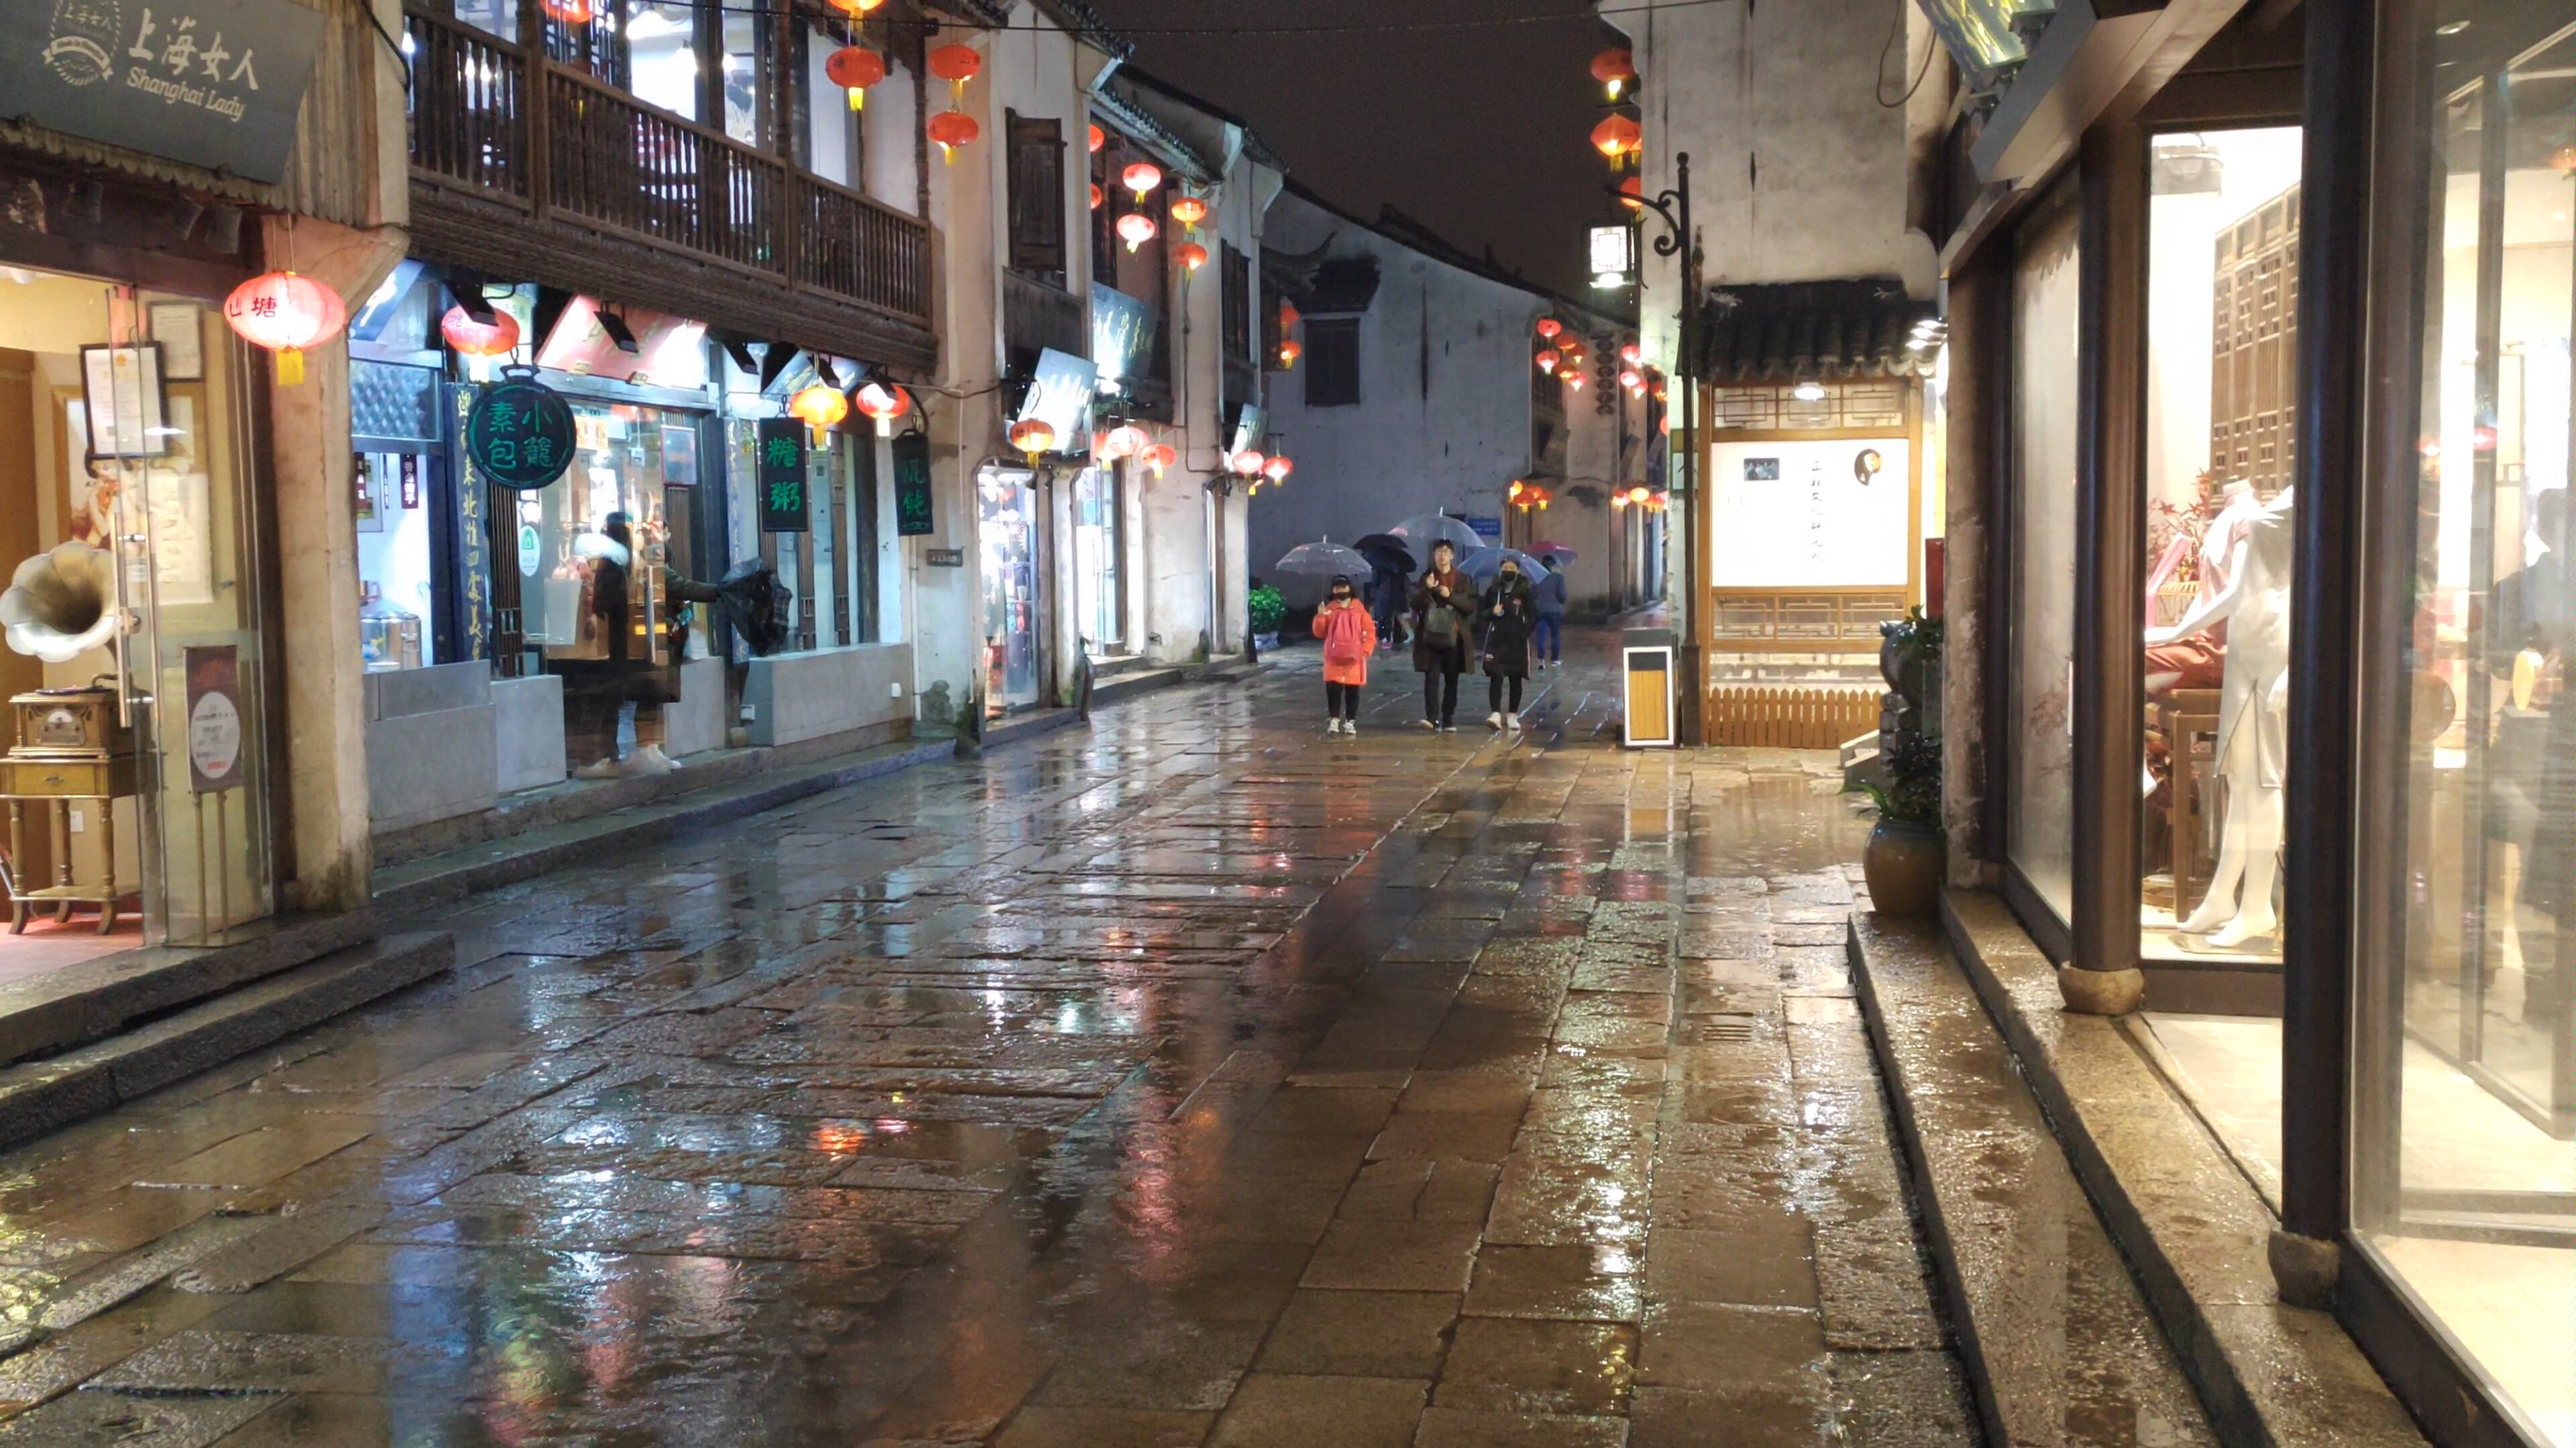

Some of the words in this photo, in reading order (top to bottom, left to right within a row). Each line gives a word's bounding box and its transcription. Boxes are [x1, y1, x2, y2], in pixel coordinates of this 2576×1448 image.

[128, 7, 258, 90] 上海女人
[126, 65, 205, 106] Shanghai
[205, 89, 246, 122] Lady
[230, 296, 277, 317] 山塘
[767, 437, 801, 512] 糖粥
